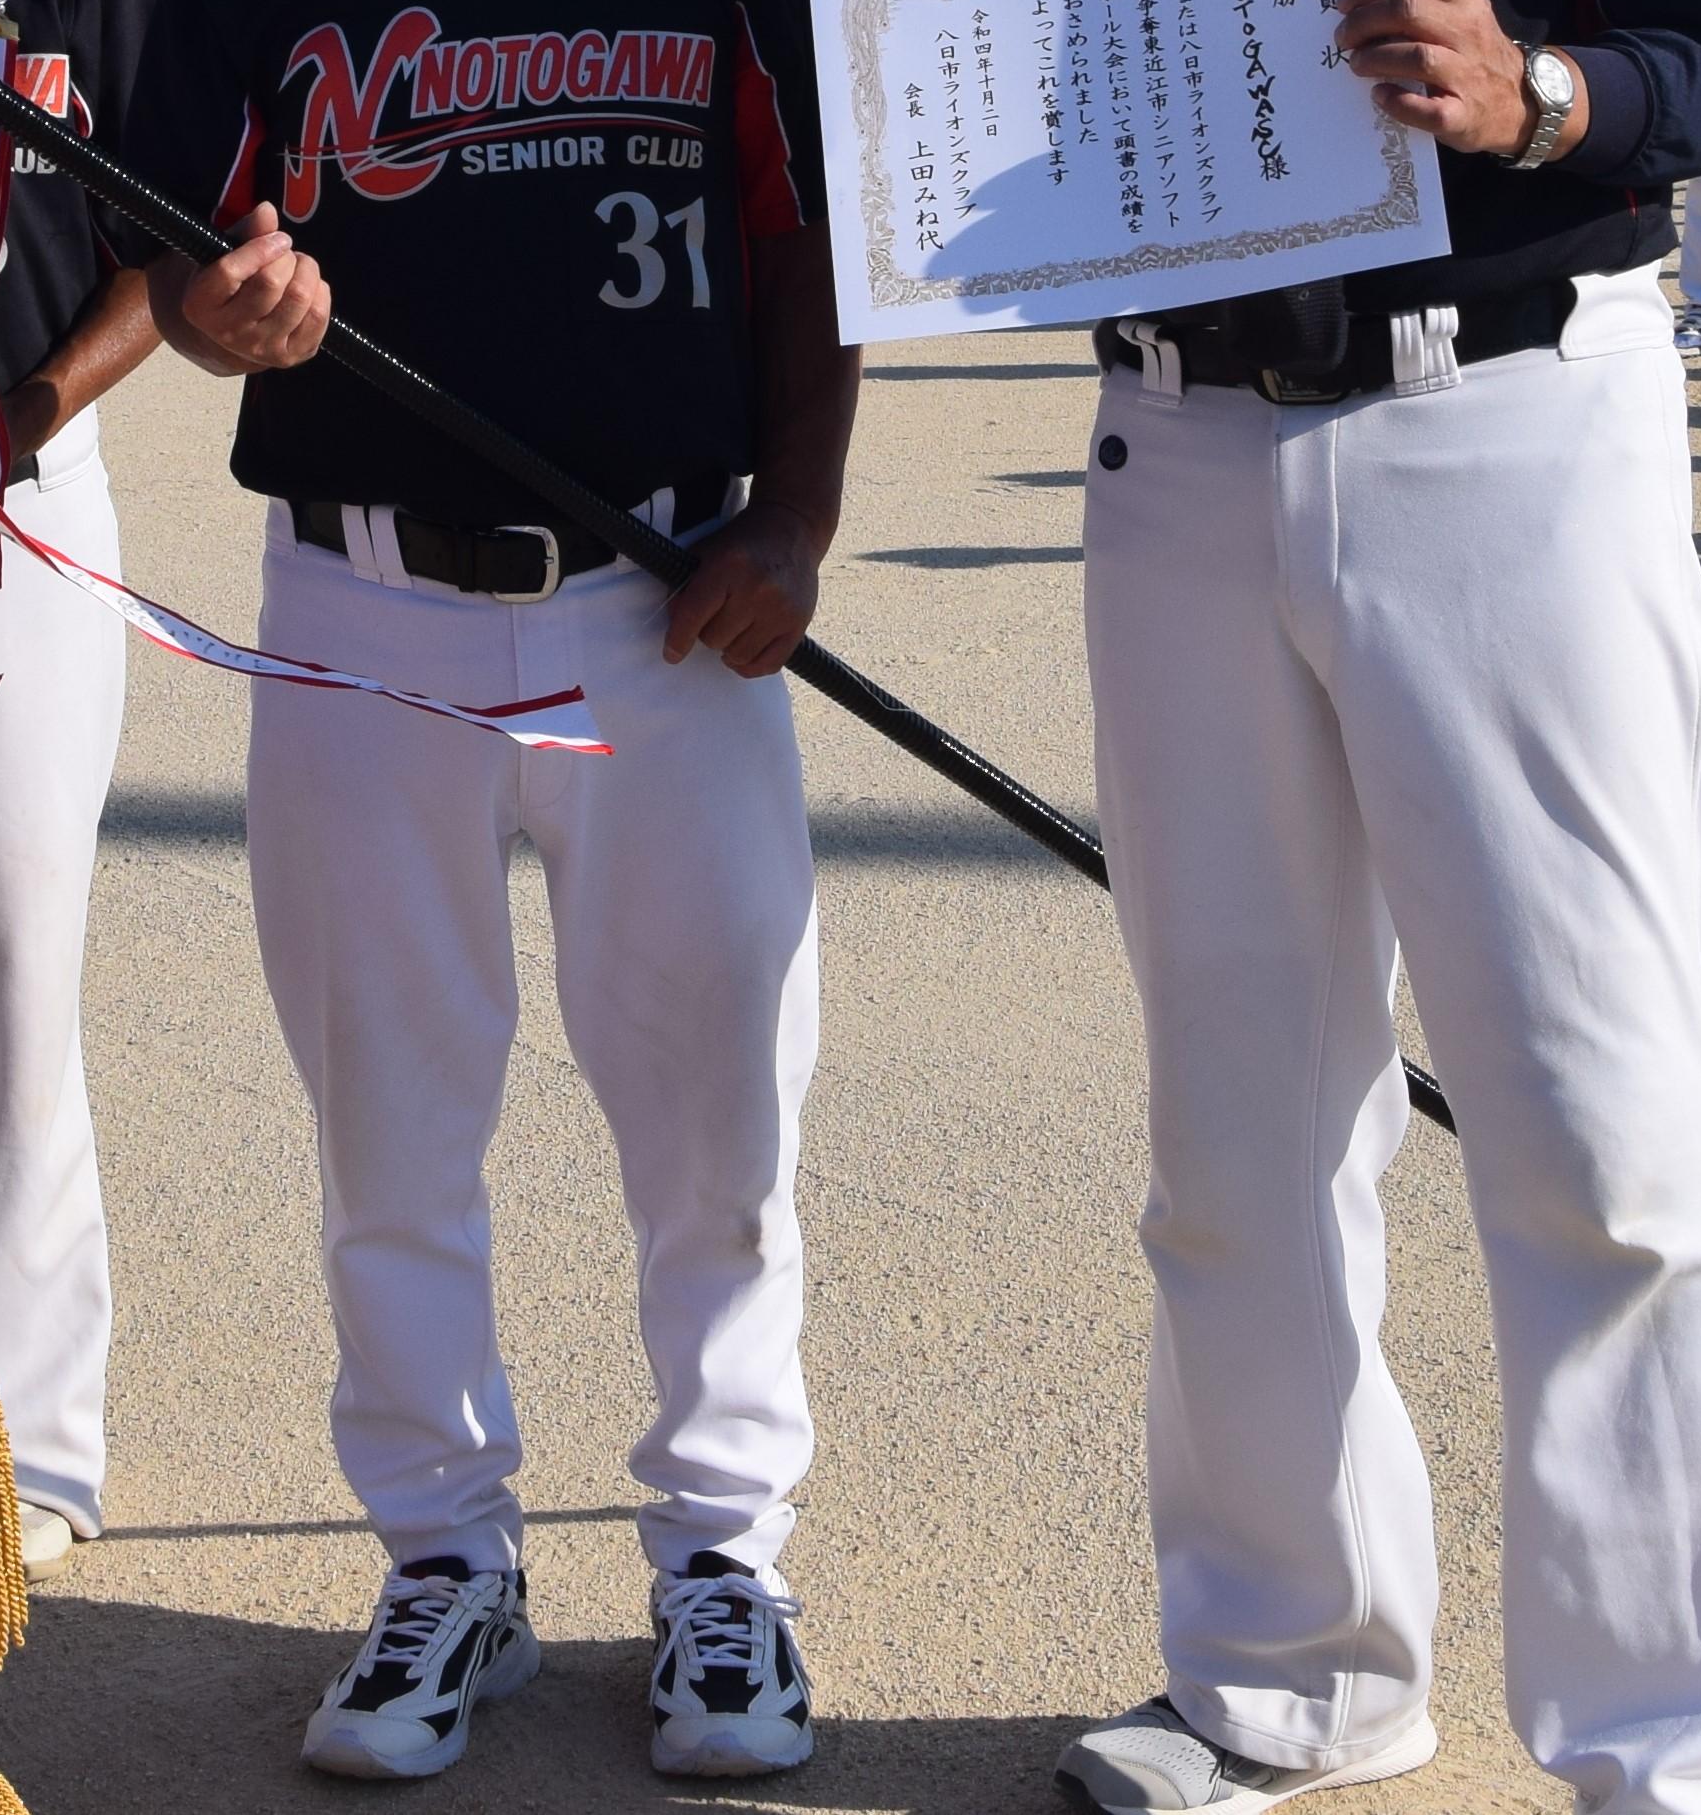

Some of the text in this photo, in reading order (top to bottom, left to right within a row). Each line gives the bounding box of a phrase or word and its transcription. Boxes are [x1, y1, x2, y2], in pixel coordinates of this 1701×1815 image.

[409, 28, 716, 120] NOTOGAWA
[934, 28, 978, 220] 八日市ライオンズクラブ
[970, 8, 1000, 138] 令和四年十月二日
[460, 134, 704, 176] SENIOR CLUB
[903, 82, 946, 252] 会長 上田みね代
[593, 190, 712, 311] 31
